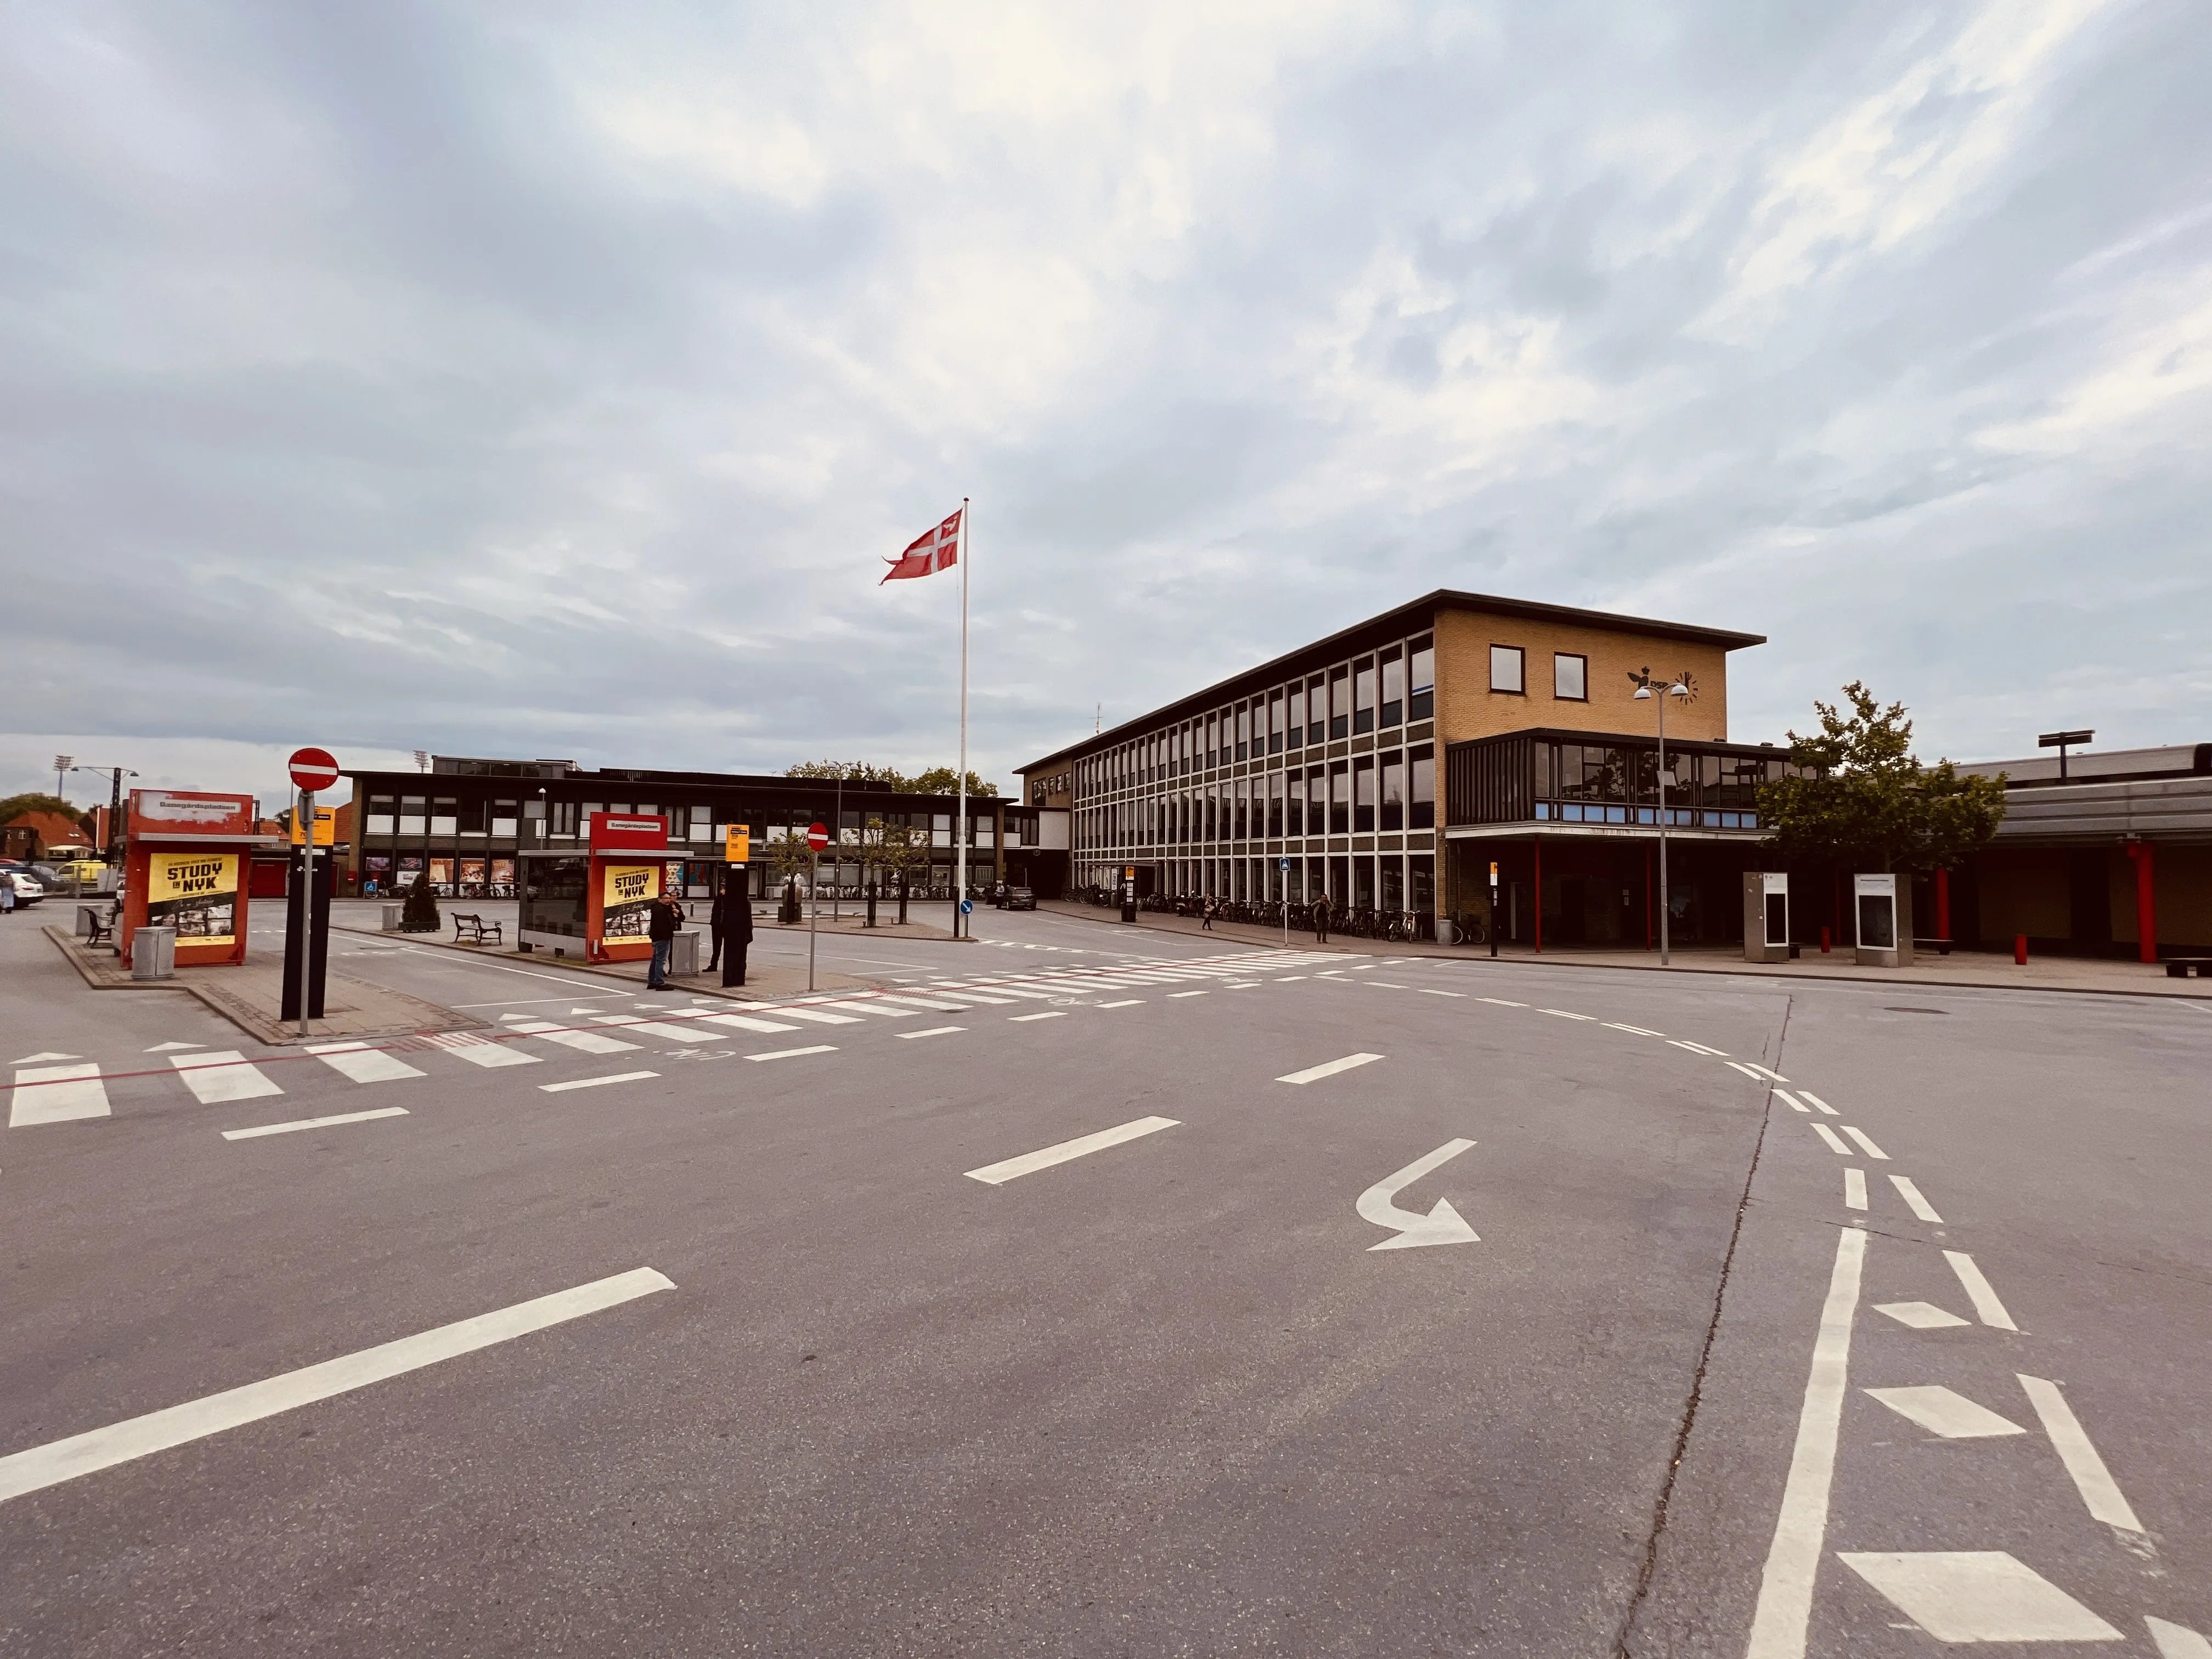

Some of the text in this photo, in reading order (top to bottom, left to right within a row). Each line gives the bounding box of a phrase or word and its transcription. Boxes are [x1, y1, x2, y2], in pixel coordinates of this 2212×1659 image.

[167, 862, 222, 880] STUDY
[183, 877, 216, 892] NYK
[615, 873, 649, 888] STUDY
[624, 885, 645, 898] NYK
